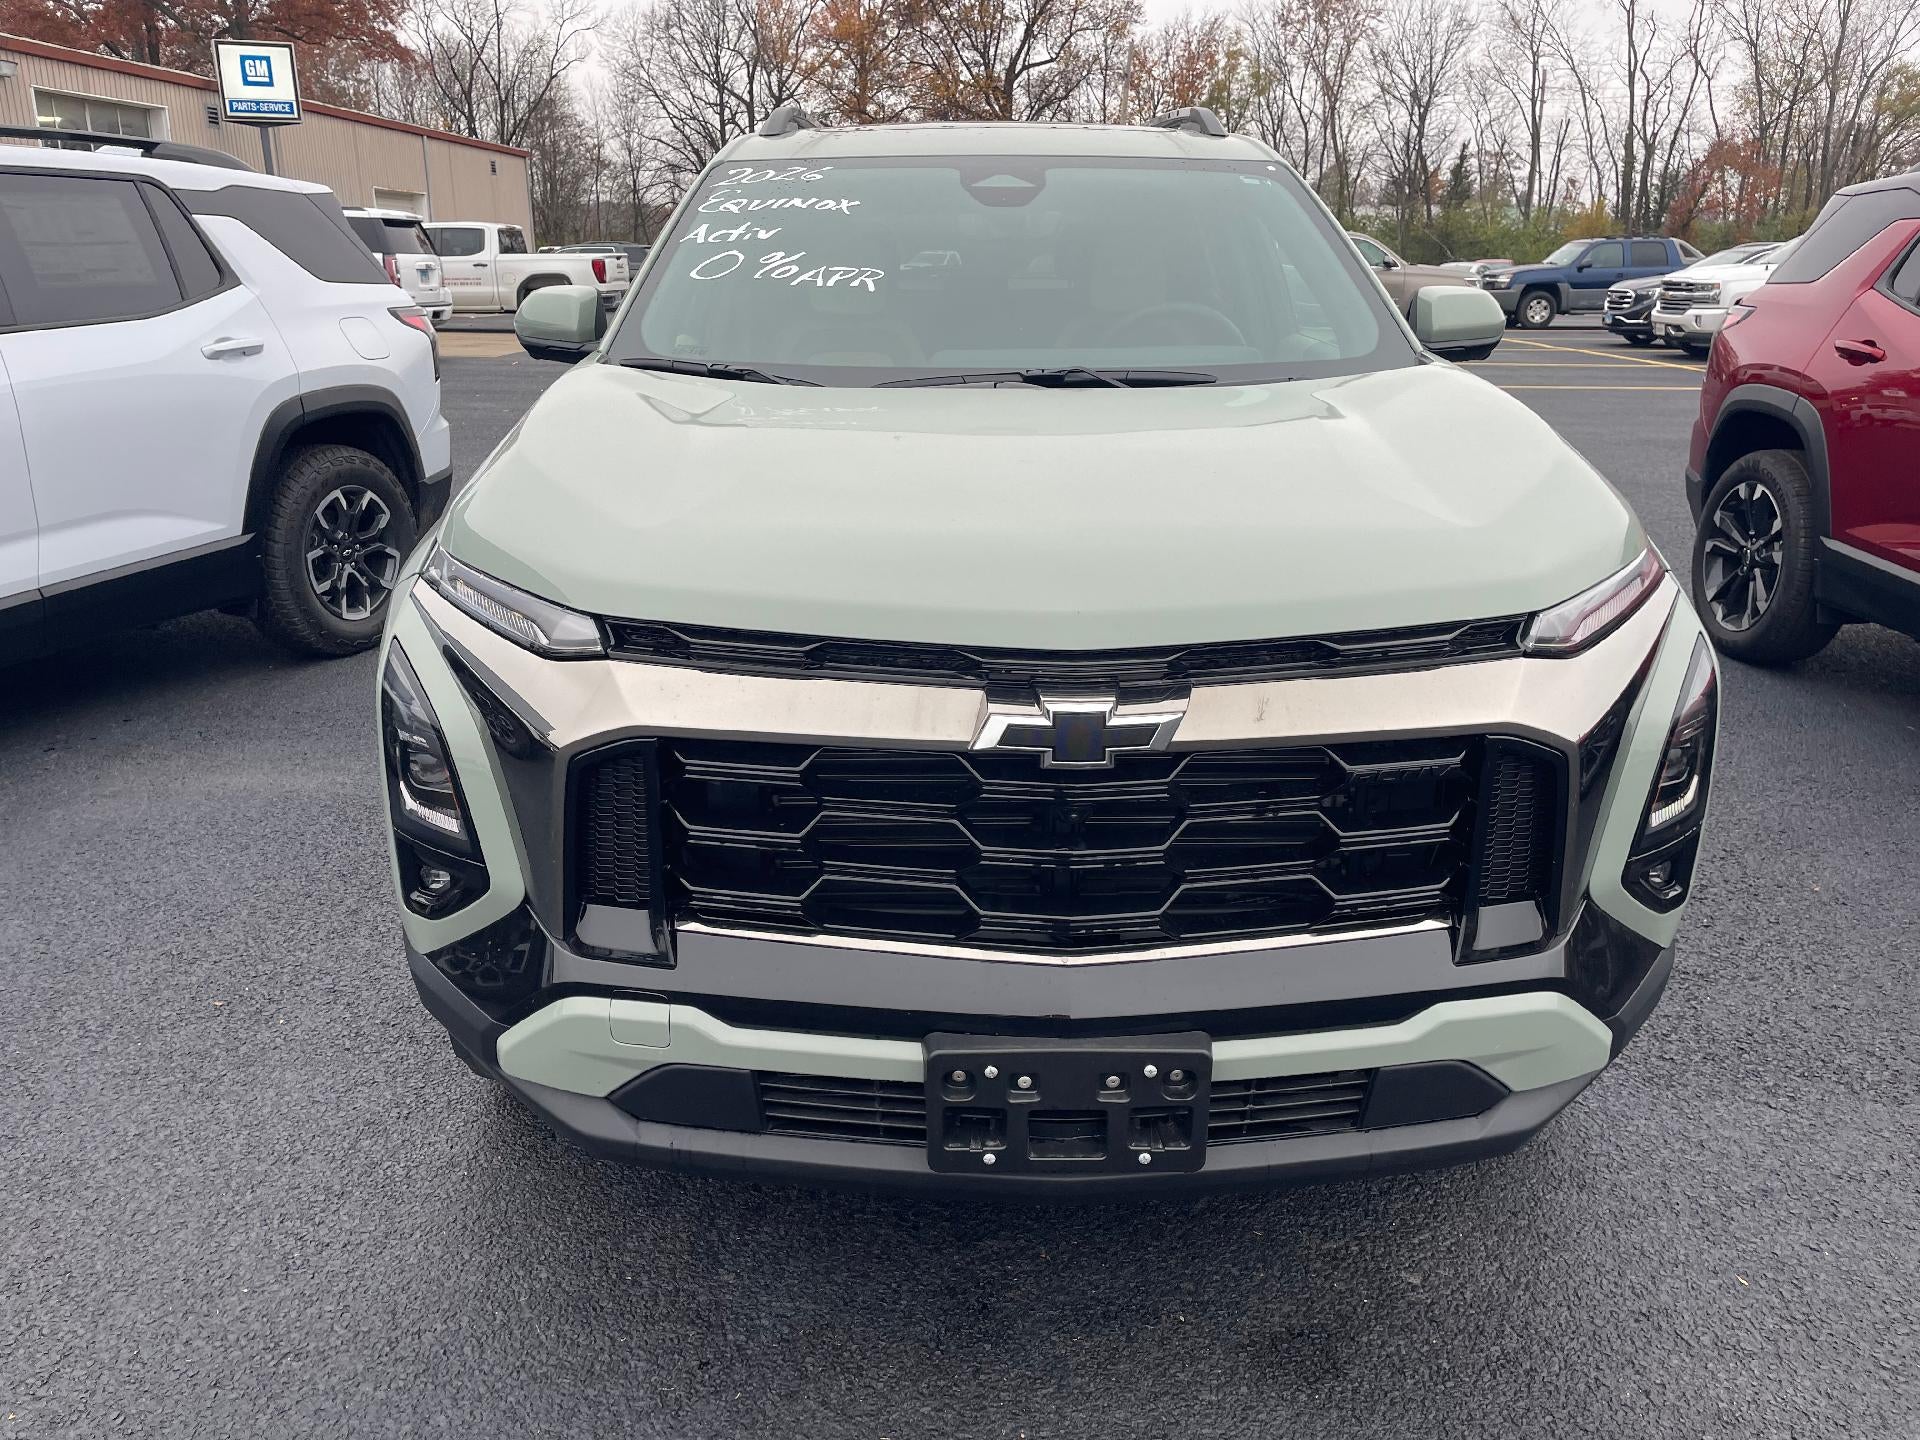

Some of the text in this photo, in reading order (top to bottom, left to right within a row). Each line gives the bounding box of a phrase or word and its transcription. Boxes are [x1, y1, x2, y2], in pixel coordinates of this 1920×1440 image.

[244, 59, 269, 77] GM
[232, 101, 291, 112] PARTS-SERVICE
[710, 166, 834, 187] 2026
